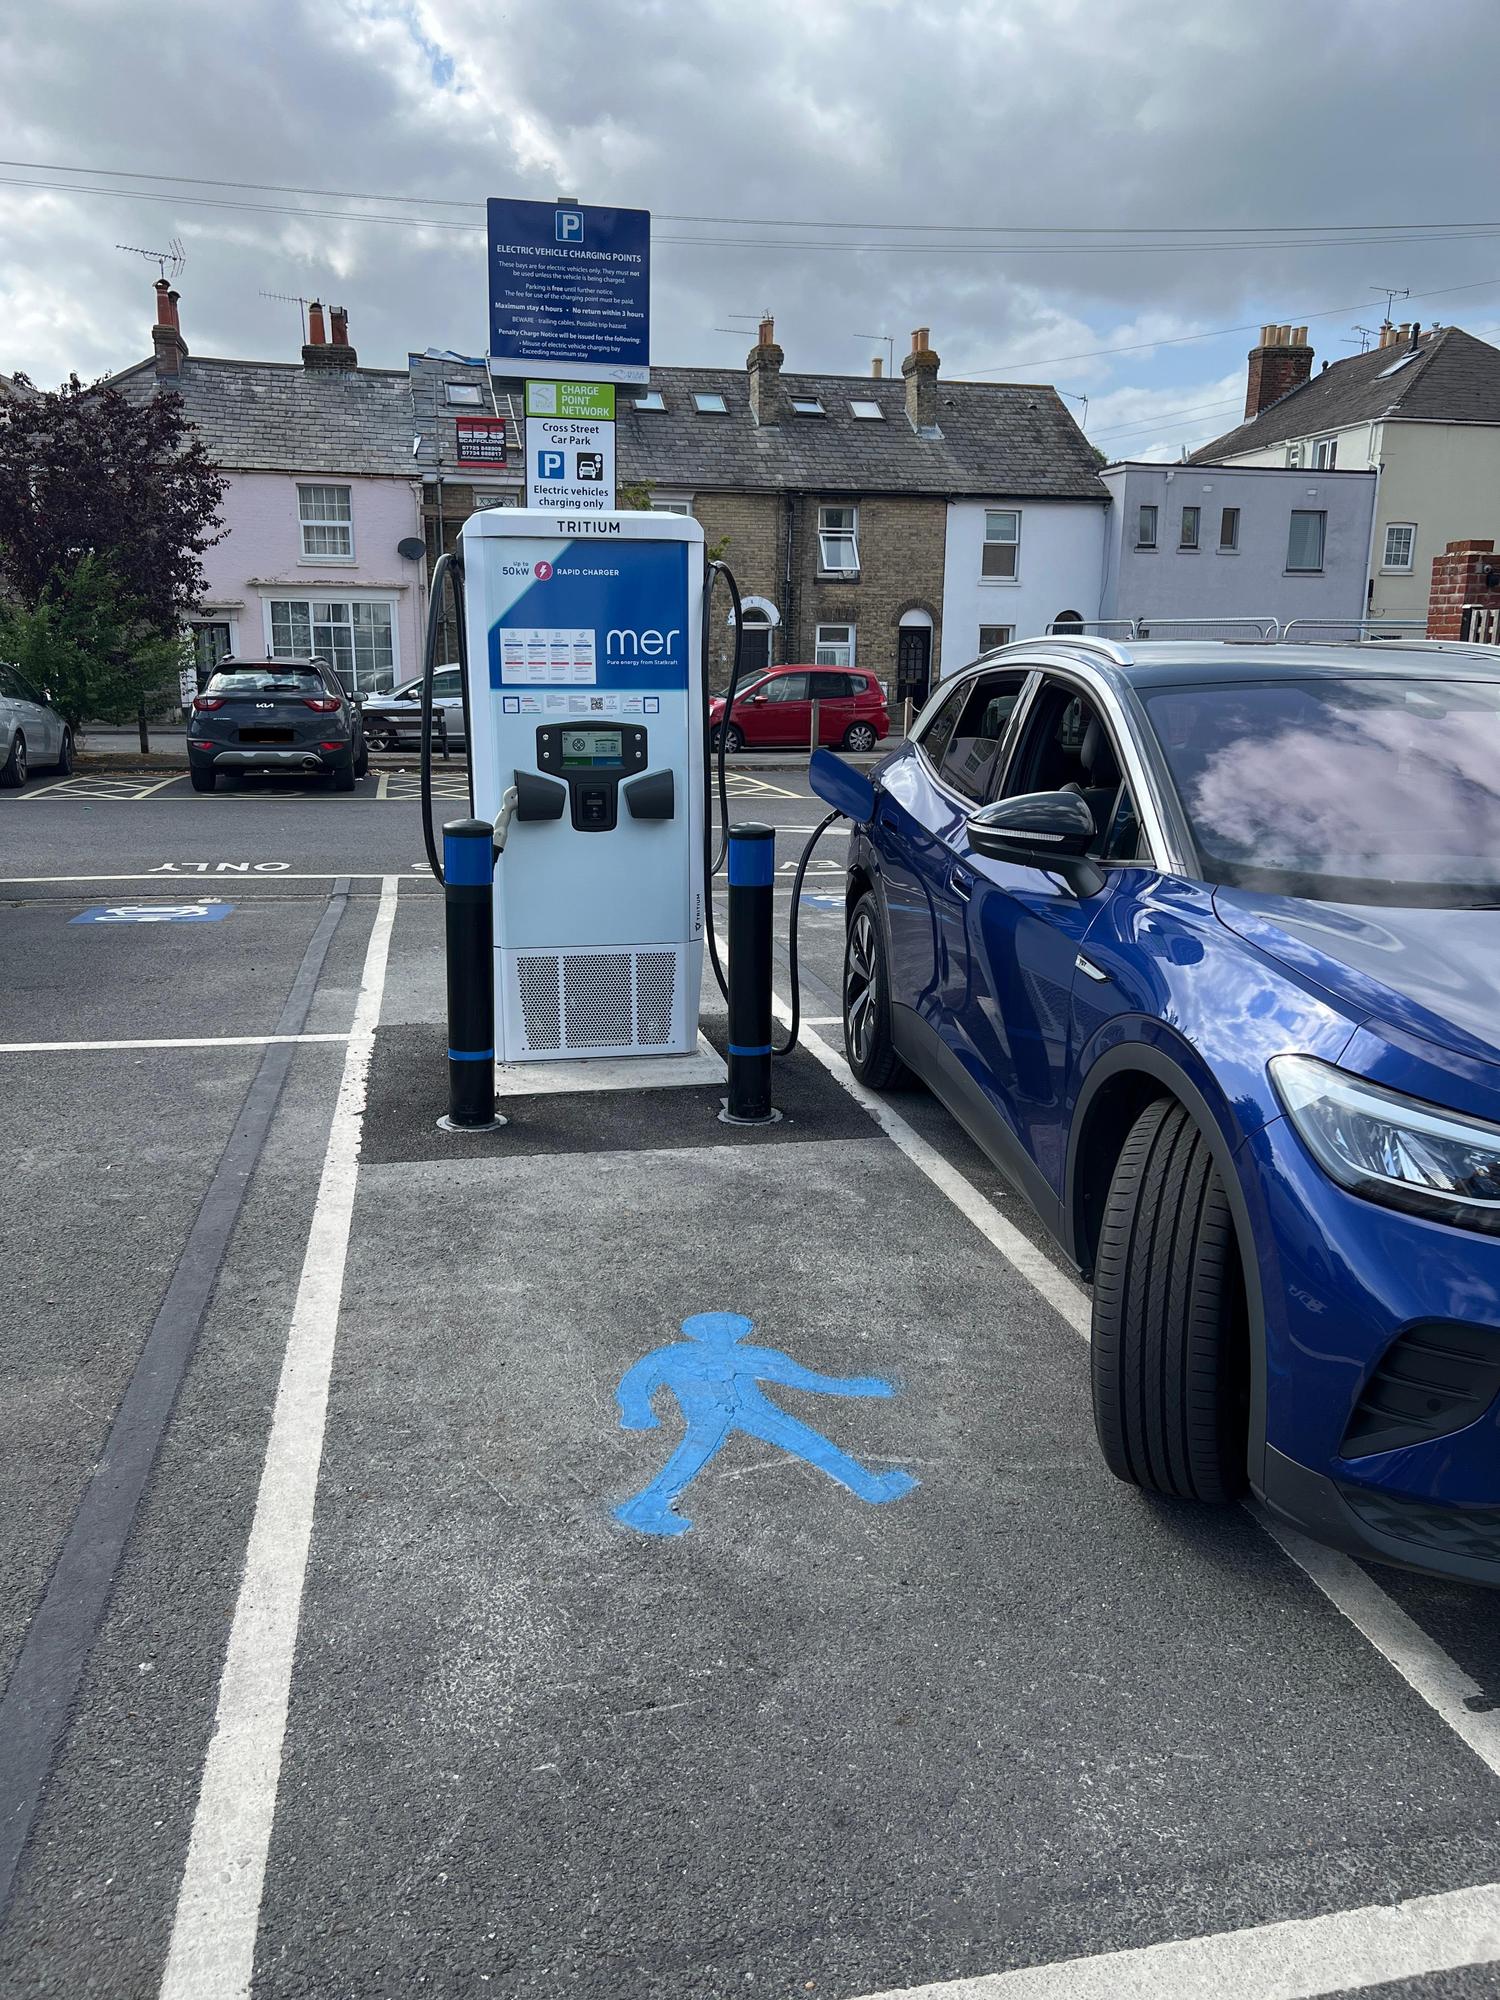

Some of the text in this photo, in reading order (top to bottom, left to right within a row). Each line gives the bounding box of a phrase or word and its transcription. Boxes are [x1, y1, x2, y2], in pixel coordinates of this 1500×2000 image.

[563, 215, 579, 238] P
[497, 245, 641, 262] ELECTRIC VEHICLE CHARGING POINTS
[522, 348, 549, 356] Exceeding
[561, 385, 599, 395] CHARGE
[562, 395, 590, 405] POINT
[562, 406, 609, 416] NETWORK
[542, 423, 599, 434] Cross Street
[551, 435, 591, 445] Car Park
[544, 454, 561, 476] P
[534, 485, 608, 496] Electric vehicles
[539, 497, 604, 510] charging only
[557, 521, 620, 533] TRITIUM
[502, 567, 529, 576] 50kW
[606, 630, 680, 655] mer
[148, 862, 292, 872] ONLY
